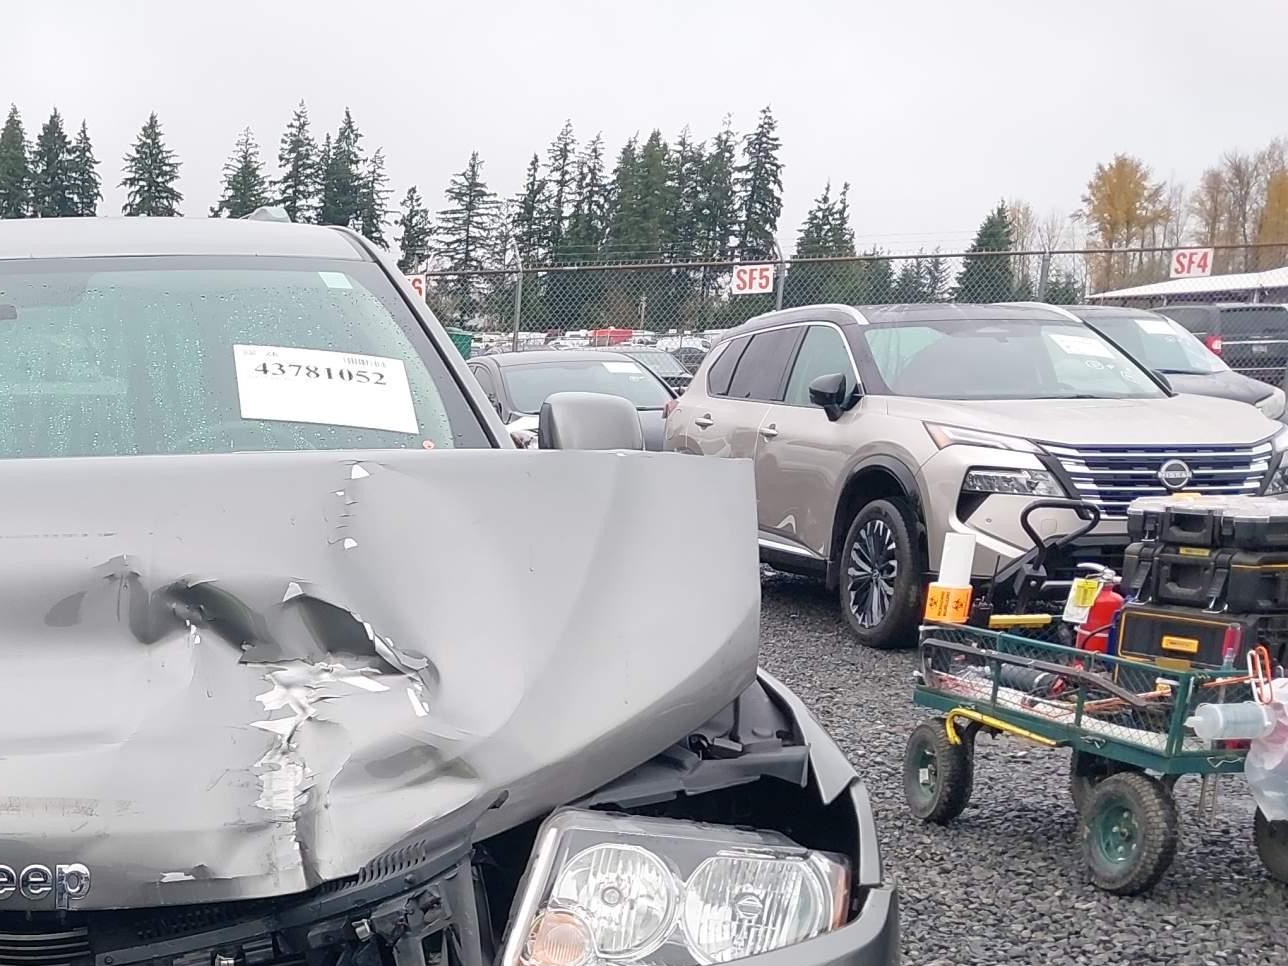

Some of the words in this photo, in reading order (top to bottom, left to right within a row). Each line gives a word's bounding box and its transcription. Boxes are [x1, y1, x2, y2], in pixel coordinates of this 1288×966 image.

[1174, 251, 1209, 274] SF4
[735, 267, 770, 291] SF5
[253, 362, 388, 386] 43781052
